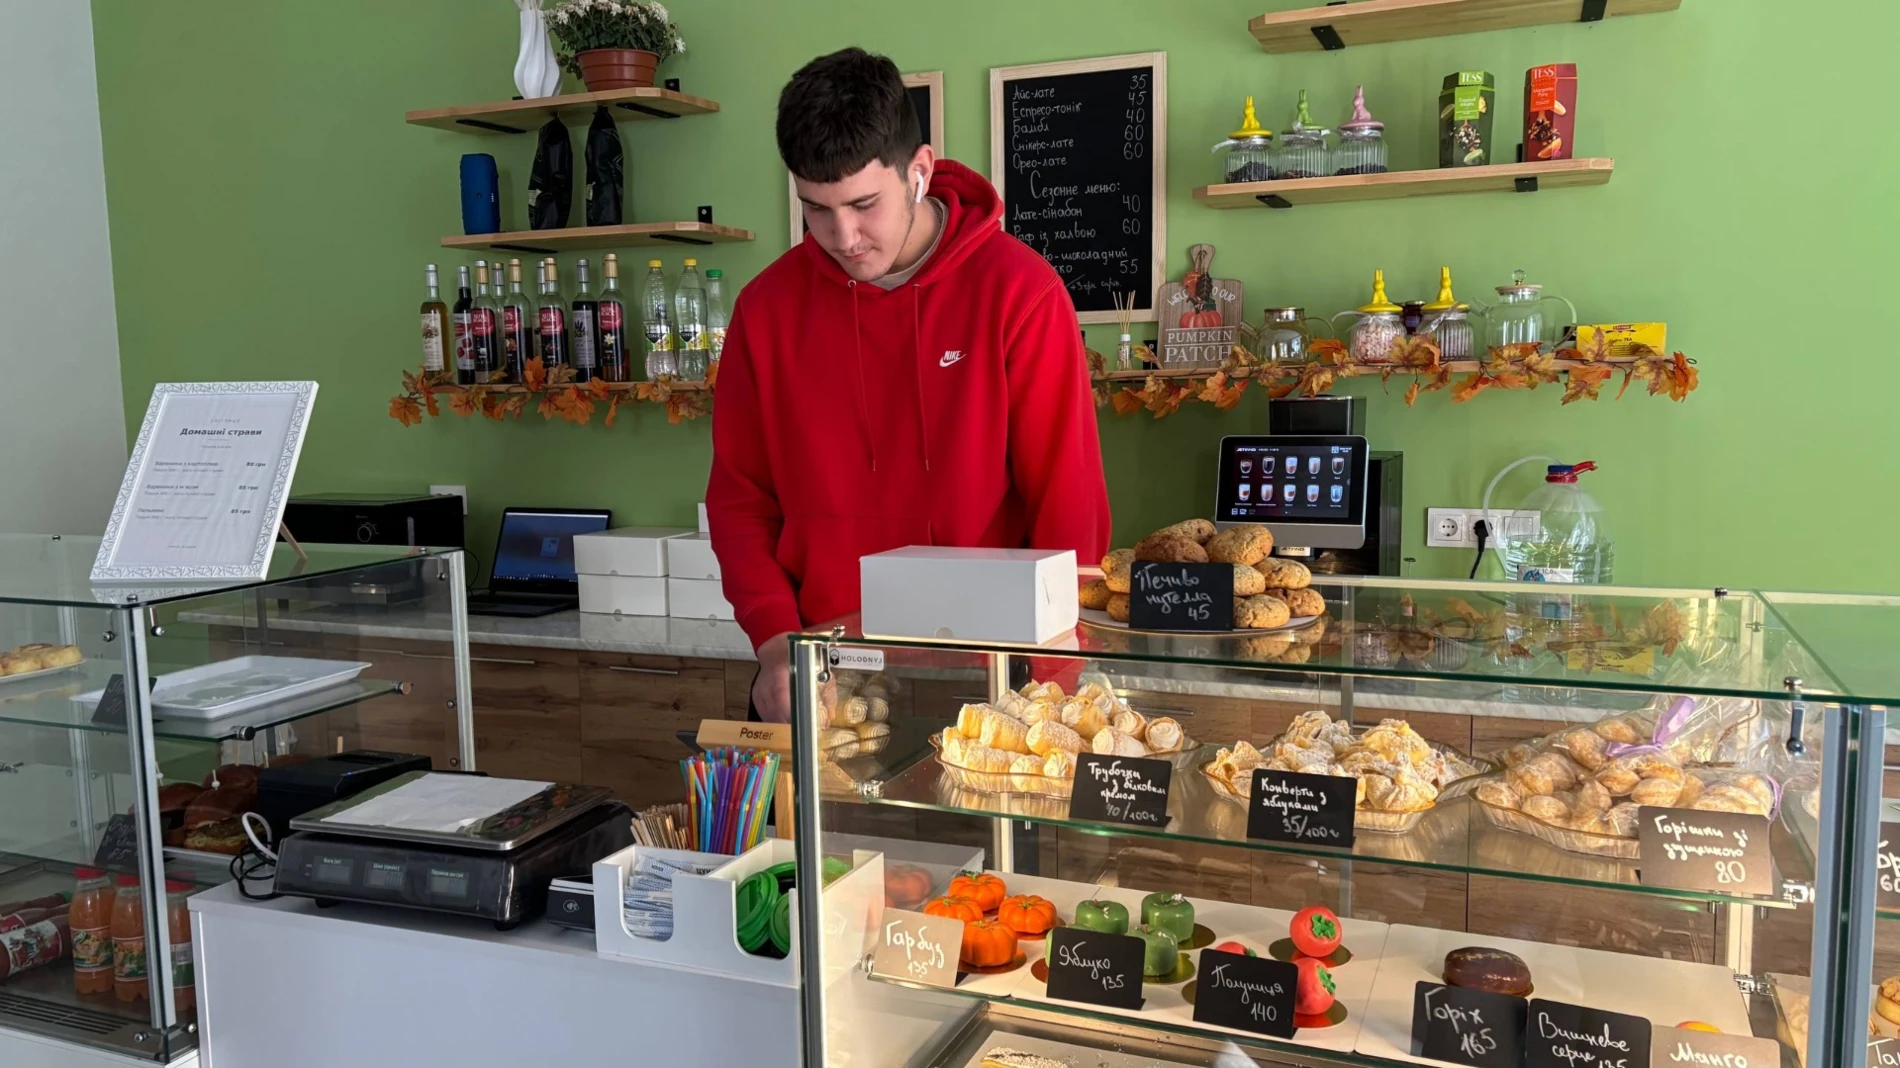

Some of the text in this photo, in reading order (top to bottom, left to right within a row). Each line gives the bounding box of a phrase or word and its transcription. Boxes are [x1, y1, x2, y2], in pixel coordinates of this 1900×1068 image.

[1461, 72, 1482, 83] TESS
[1534, 67, 1555, 79] TESS
[1012, 74, 1148, 100] Айс-лате 35
[1012, 91, 1147, 123] Еспресо-тонік 45
[1125, 108, 1145, 123] 40
[1012, 124, 1144, 155] Снікерс-лате 60
[1013, 142, 1143, 175] Орео-лате 60
[1030, 170, 1121, 206] Сезонне меню:
[1013, 194, 1140, 221] Лате-сінабон 40
[1040, 231, 1049, 248] із
[1055, 221, 1096, 239] халвою
[1122, 218, 1140, 234] 60
[1120, 258, 1138, 274] 55
[1167, 289, 1189, 306] WELC
[1220, 289, 1236, 303] OUR
[1167, 330, 1233, 343] PUMPKIN
[944, 350, 961, 360] NIKE
[1164, 345, 1234, 363] PATCH
[179, 428, 262, 437] Домашні страви
[1134, 563, 1200, 591] Печиво
[1146, 591, 1213, 614] нутелла
[1188, 604, 1210, 620] 45
[841, 655, 882, 664] HOLODNYJ
[739, 727, 774, 741] Poster
[1088, 760, 1141, 782] Трубочки
[1100, 788, 1136, 803] кремом
[1261, 777, 1314, 802] Конверти
[1262, 795, 1319, 816] яблуками
[1654, 815, 1724, 841] Горішки
[1715, 861, 1746, 883] 80
[886, 920, 945, 969] Гарбуз
[907, 961, 928, 976] 135
[1059, 941, 1111, 980] Яблуко
[1102, 974, 1124, 991] 135
[1211, 963, 1284, 1004] Полуниця
[1251, 1002, 1277, 1021] 140
[1425, 986, 1484, 1034] Горіх
[1461, 1028, 1497, 1059] 165
[1538, 1012, 1630, 1052] Вишневе
[1552, 1044, 1596, 1068] серце
[1669, 1042, 1748, 1068] Манго
[1867, 1038, 1900, 1066] Та
